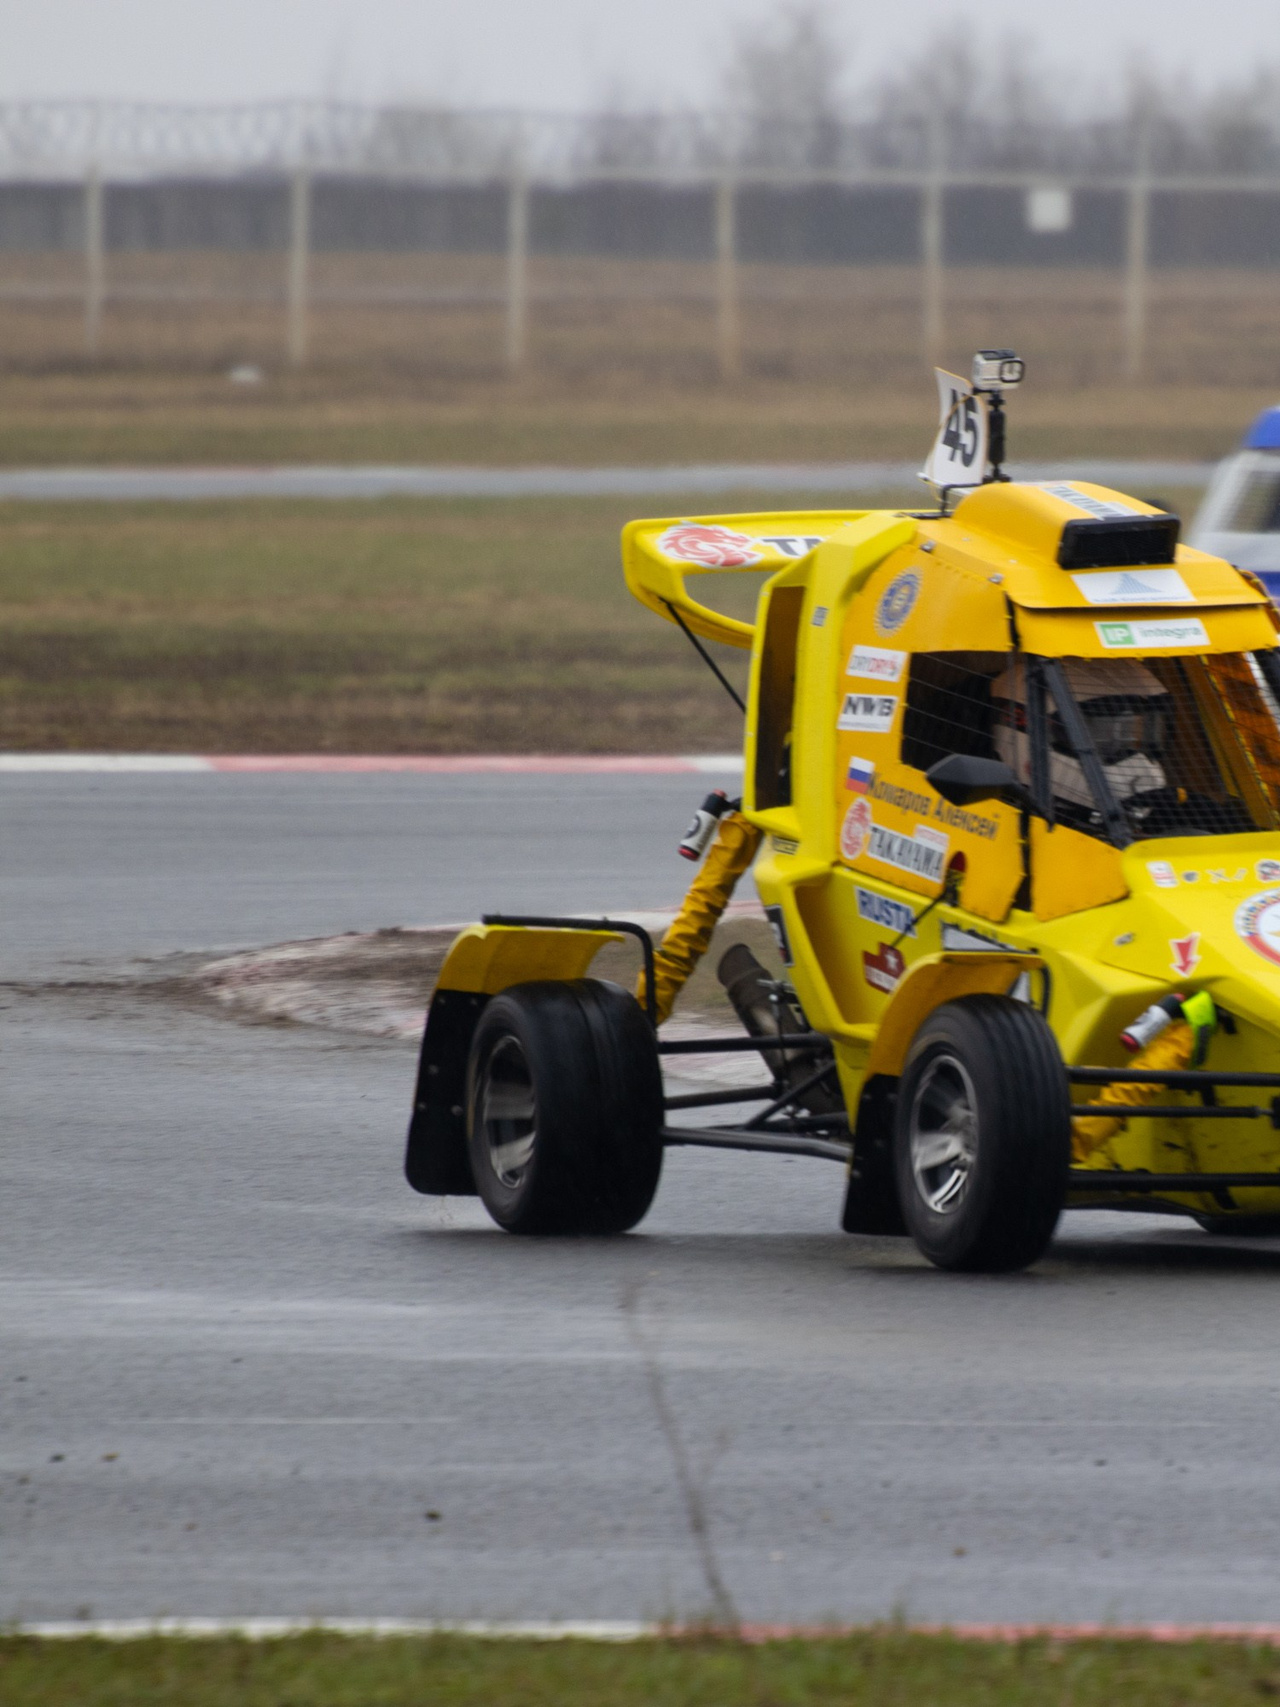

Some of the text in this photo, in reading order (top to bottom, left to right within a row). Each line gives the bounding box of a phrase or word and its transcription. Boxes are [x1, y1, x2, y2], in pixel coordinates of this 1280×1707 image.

[942, 387, 979, 468] 45
[1138, 626, 1202, 640] integra
[843, 695, 895, 717] NWB
